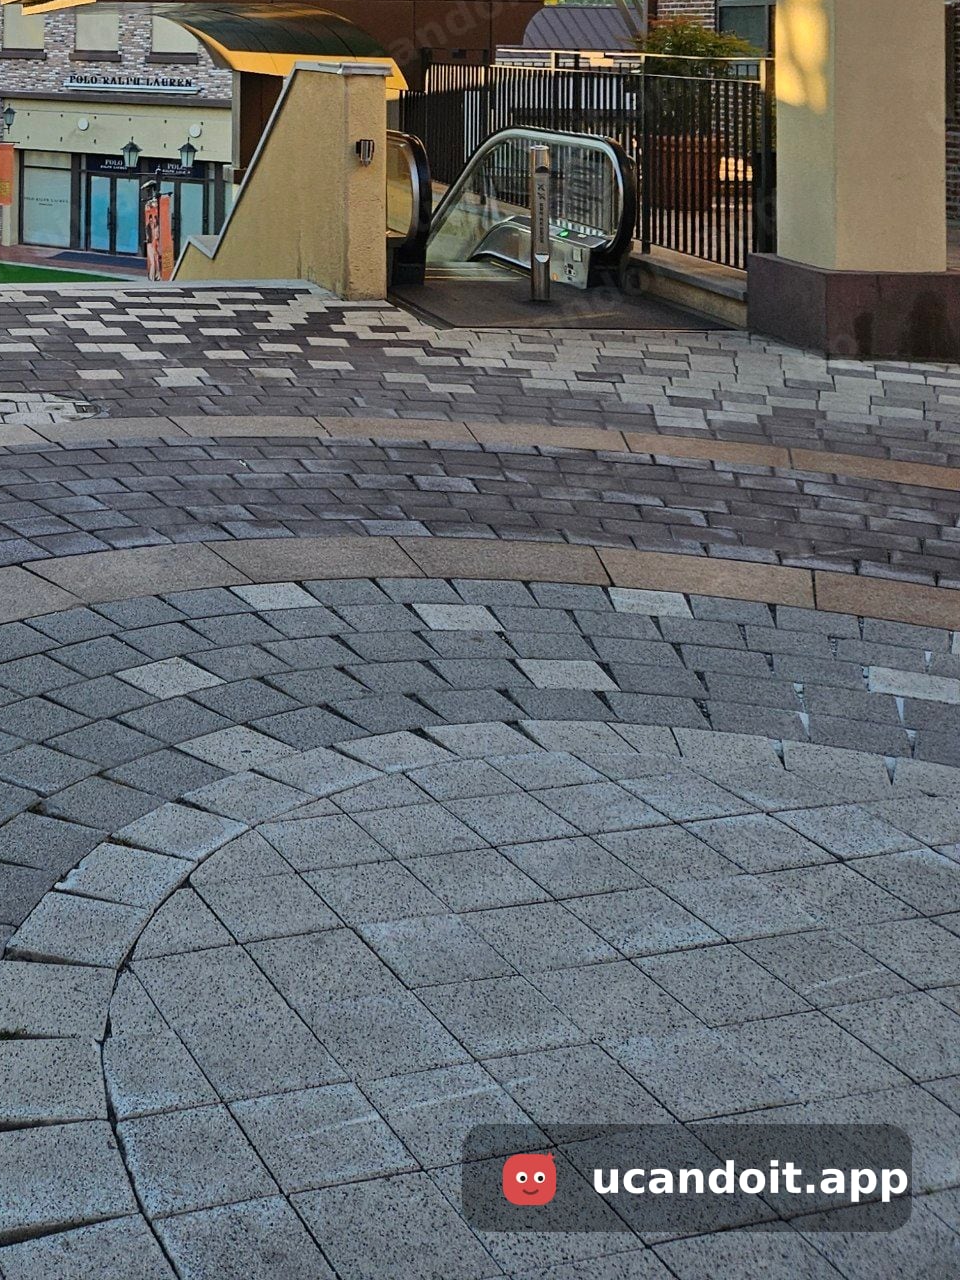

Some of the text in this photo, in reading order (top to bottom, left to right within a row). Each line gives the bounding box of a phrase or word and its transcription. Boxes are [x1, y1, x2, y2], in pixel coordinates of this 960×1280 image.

[69, 75, 192, 87] POLO RALPH LAUREN
[105, 159, 123, 167] POLO
